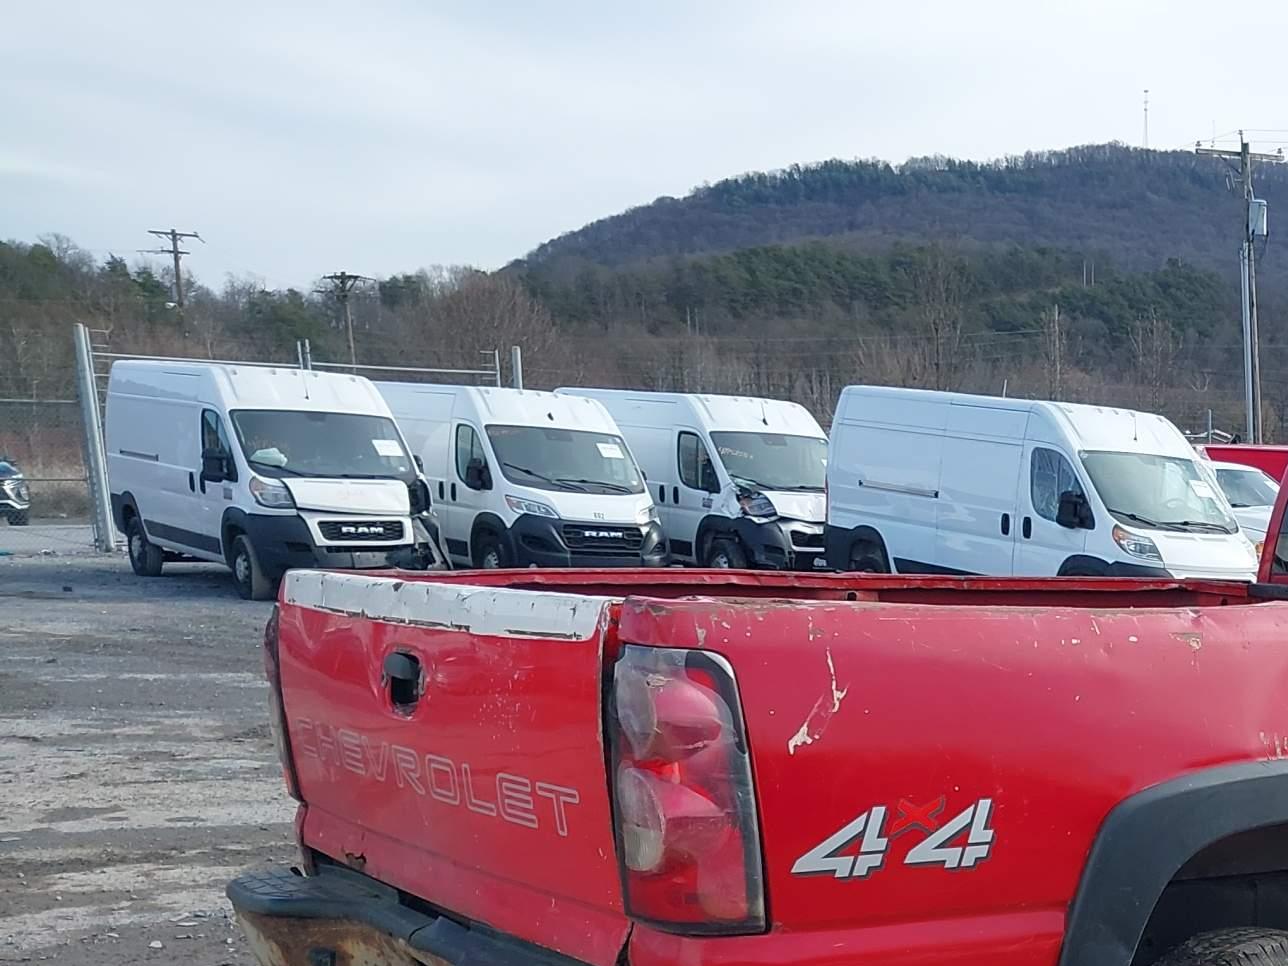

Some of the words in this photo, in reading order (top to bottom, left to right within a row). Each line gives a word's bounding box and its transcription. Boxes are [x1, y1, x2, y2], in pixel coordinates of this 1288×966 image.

[341, 526, 384, 534] RAM
[584, 530, 623, 538] RAM
[297, 716, 580, 837] CHEVROLET
